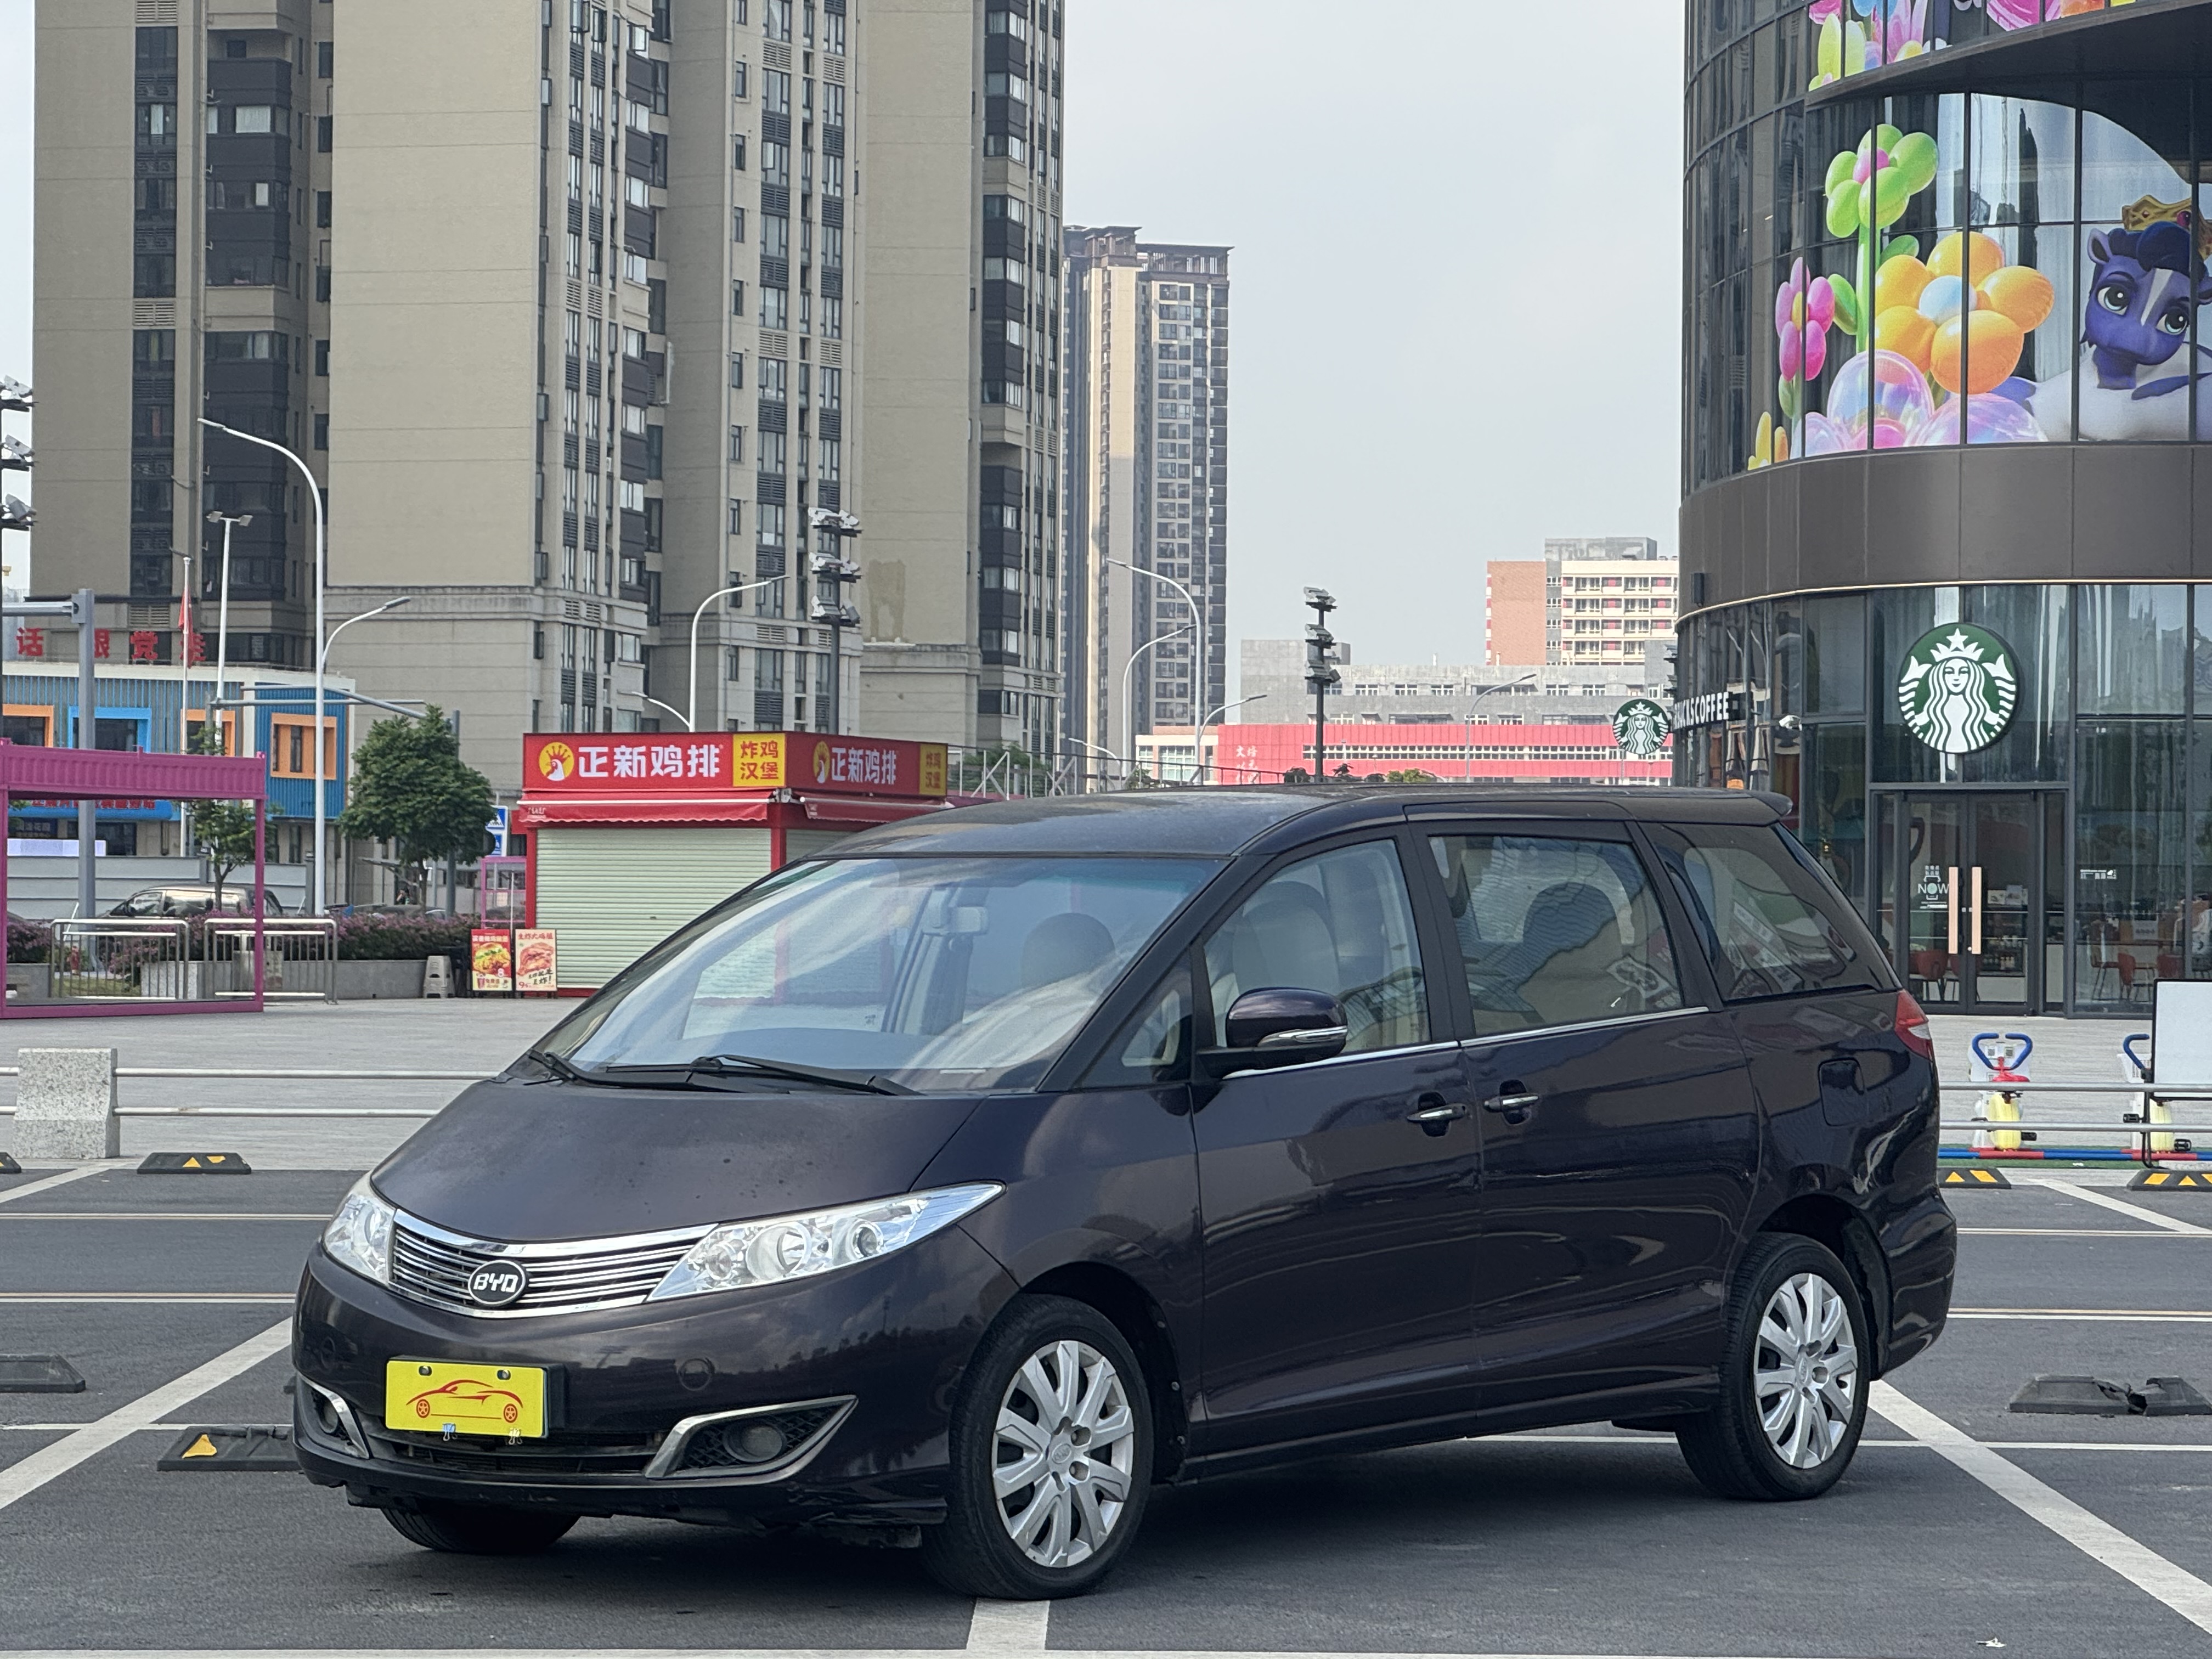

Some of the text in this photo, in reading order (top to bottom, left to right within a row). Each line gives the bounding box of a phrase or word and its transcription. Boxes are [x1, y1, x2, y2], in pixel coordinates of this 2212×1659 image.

[740, 740, 778, 758] 炸鸡
[579, 744, 720, 778] 正新鸡排
[740, 761, 779, 780] 汉堡
[831, 747, 896, 785] 正新鸡排
[473, 1273, 518, 1293] BYD
